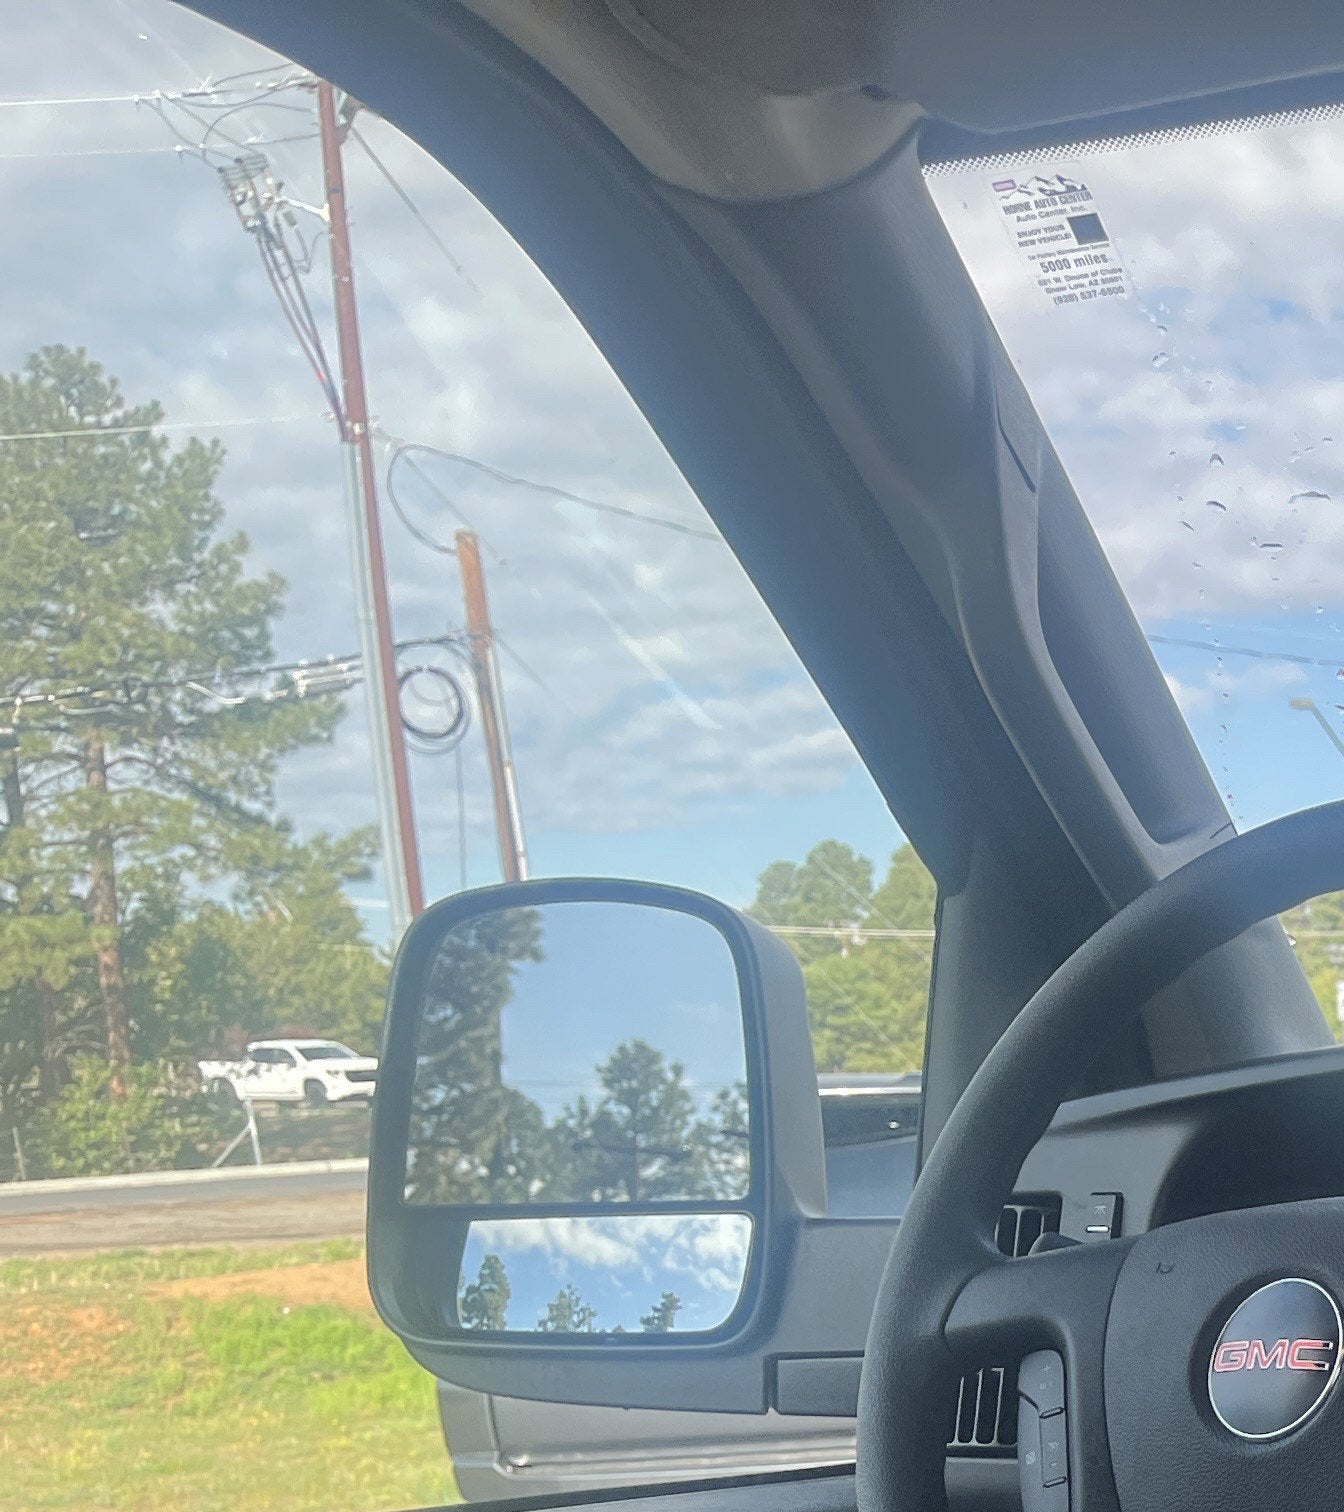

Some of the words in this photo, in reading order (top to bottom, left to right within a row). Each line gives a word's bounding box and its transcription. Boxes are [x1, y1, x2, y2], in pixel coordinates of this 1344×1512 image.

[1034, 197, 1058, 209] AUTO
[1016, 214, 1037, 223] Auto
[1017, 228, 1042, 238] ENJOY
[1042, 224, 1065, 233] YOUR
[1040, 258, 1071, 273] 5000
[1074, 253, 1108, 268] miles
[1214, 1339, 1334, 1372] GMC
